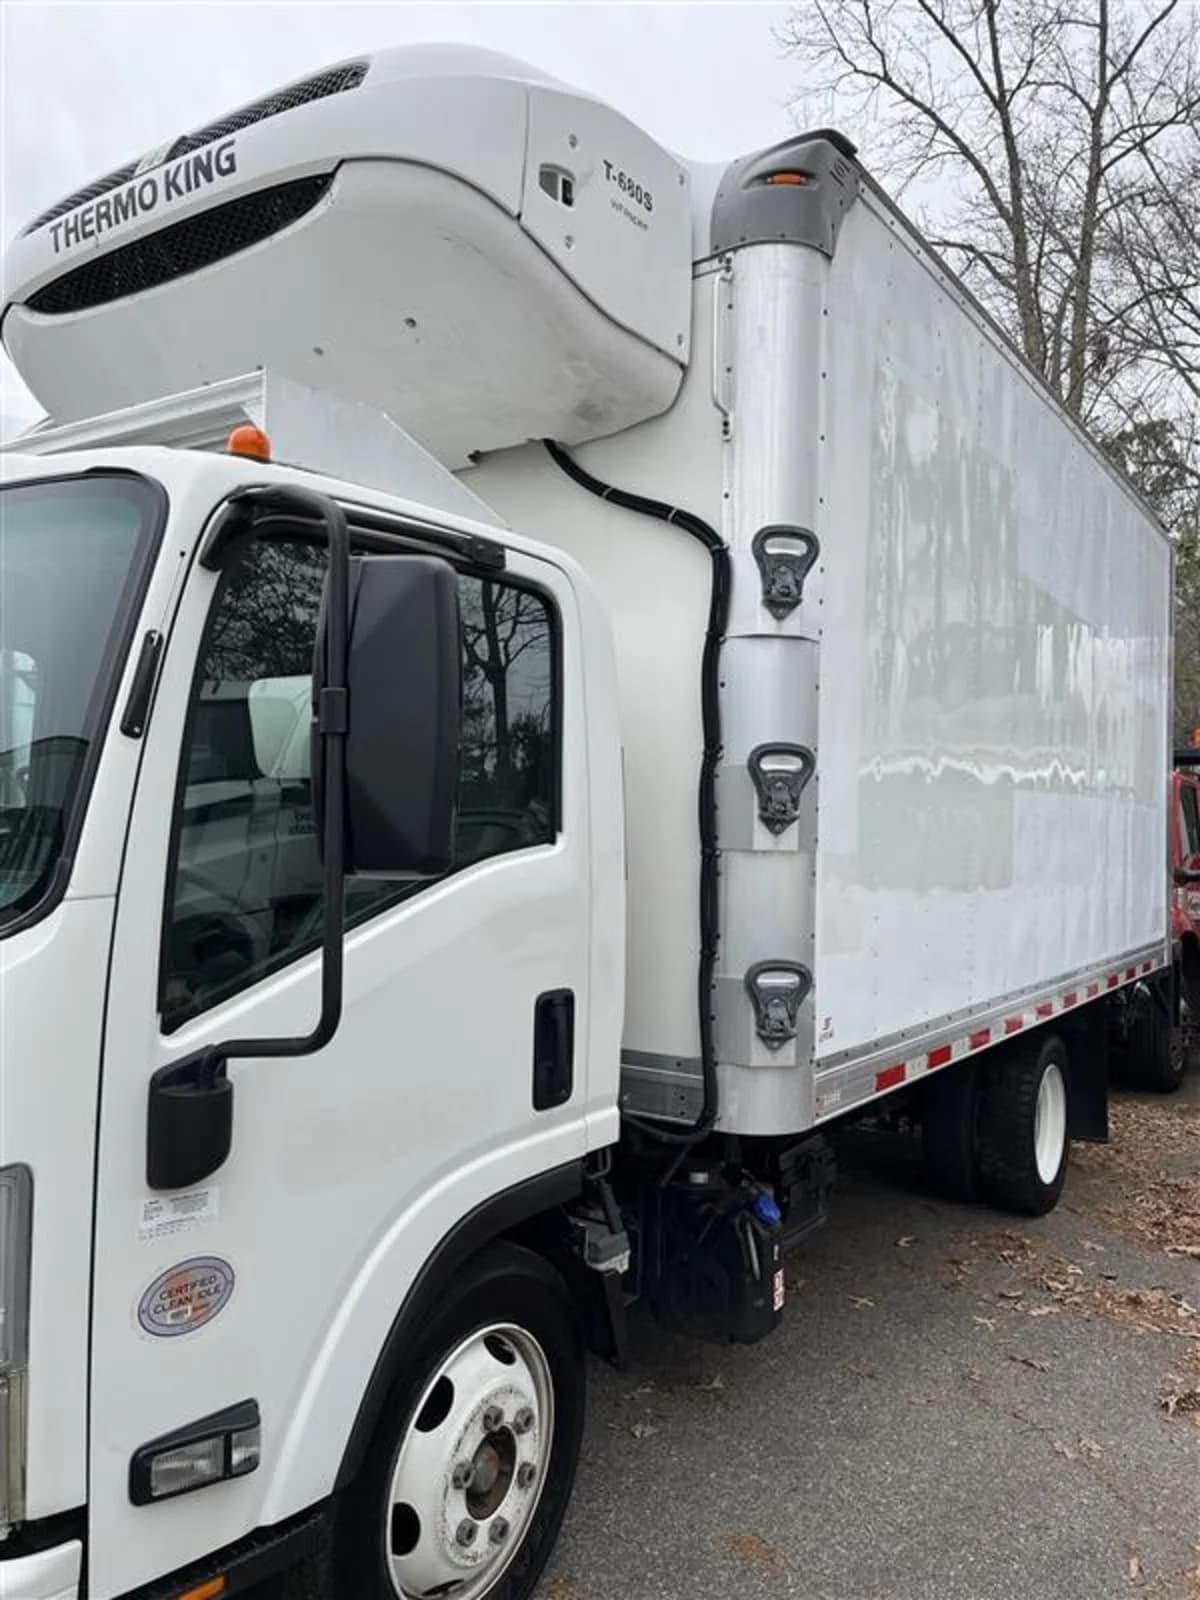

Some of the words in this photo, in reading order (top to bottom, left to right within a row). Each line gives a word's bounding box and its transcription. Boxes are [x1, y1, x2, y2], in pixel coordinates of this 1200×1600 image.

[49, 177, 158, 253] THERMO
[164, 139, 237, 202] KING
[603, 159, 653, 212] T-680S
[153, 1296, 194, 1315] CLEAN
[159, 1275, 218, 1300] CERTIFIED
